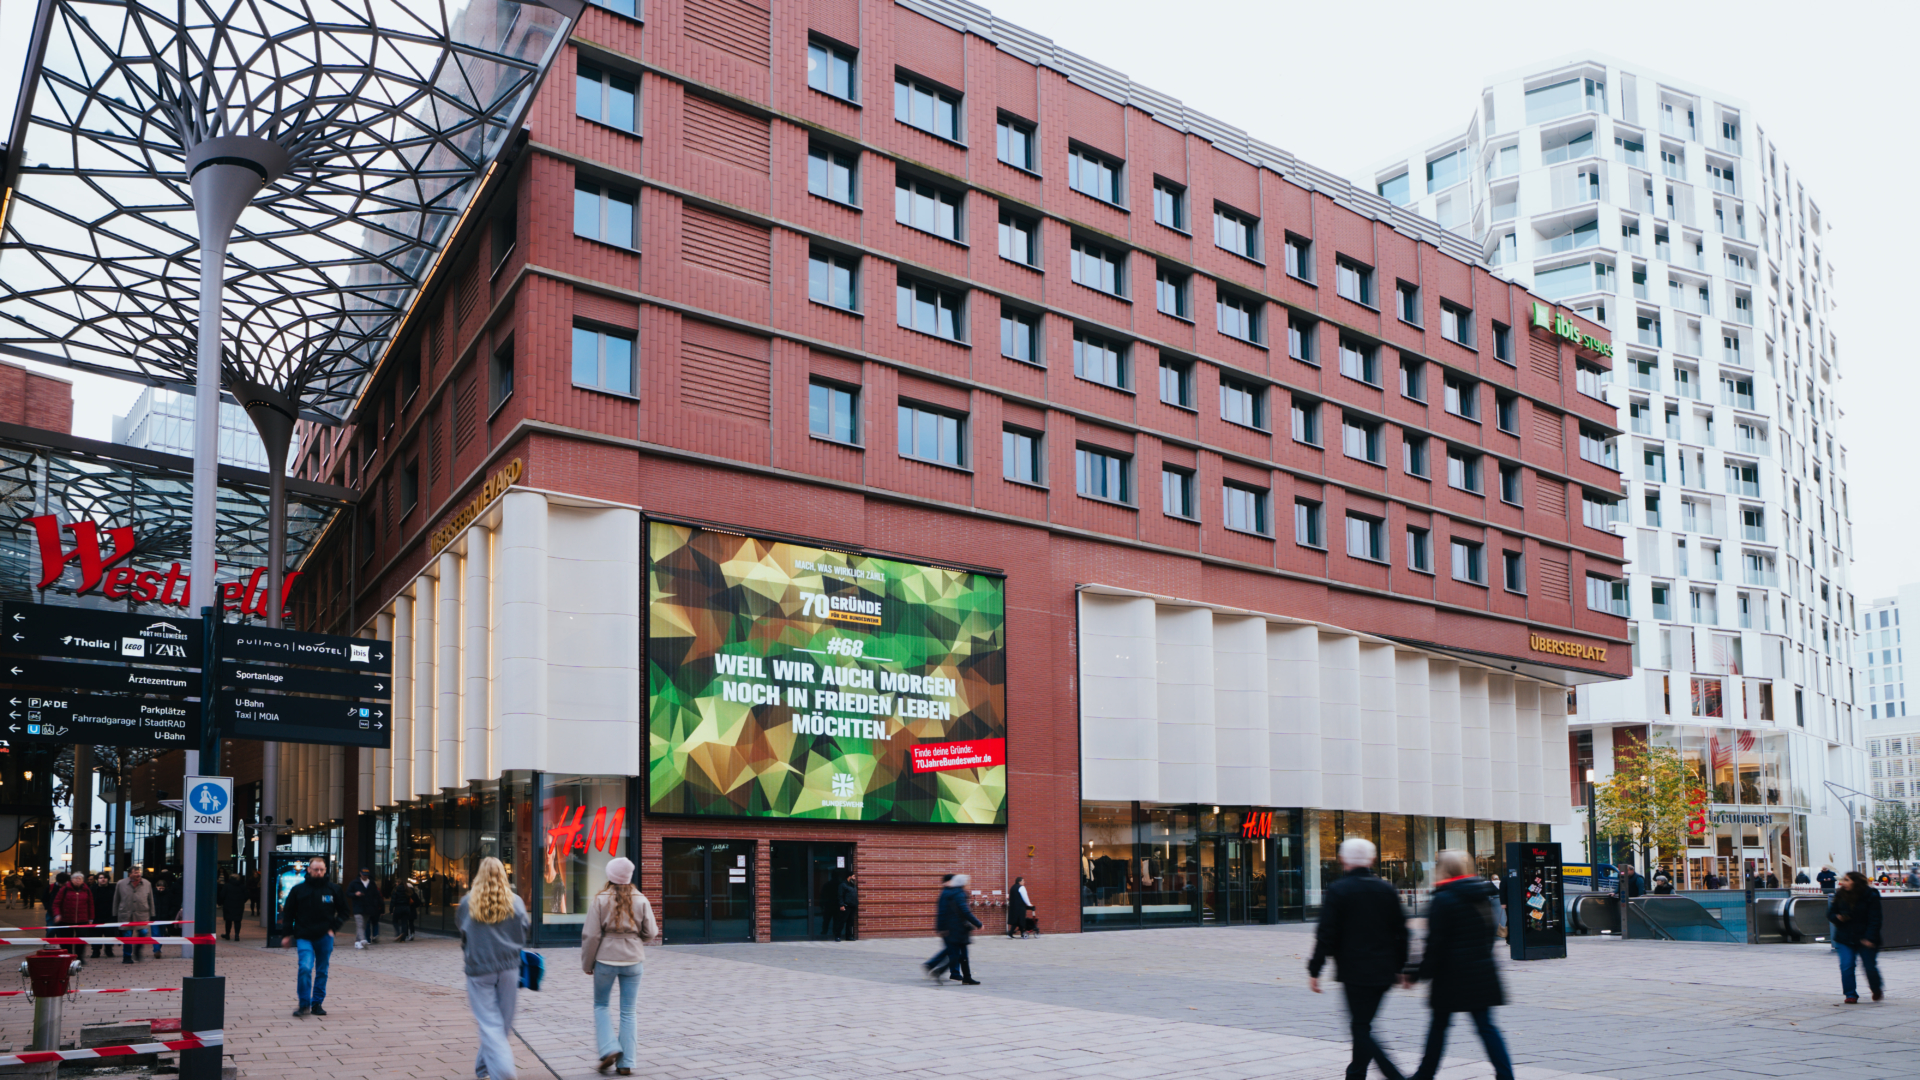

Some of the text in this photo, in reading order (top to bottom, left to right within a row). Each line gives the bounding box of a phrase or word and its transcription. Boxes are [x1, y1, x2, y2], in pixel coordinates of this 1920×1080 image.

[1554, 312, 1580, 344] ibis
[22, 514, 304, 618] Westeld
[794, 560, 886, 582] MACH, WAS WIRKLICH ZÄHLT.
[800, 592, 830, 618] 70
[830, 596, 882, 616] GRÜNDE
[74, 637, 110, 649] Thalia
[155, 643, 188, 658] ZARA
[236, 638, 366, 658] pullman NOVOTEL ibis
[826, 636, 864, 658] #68
[1530, 632, 1608, 662] ÜBERSEEPLATZ
[128, 674, 187, 687] Ärztezentrum
[236, 670, 284, 683] Sportanlage
[714, 652, 956, 698] WEIL WIR AUCH MORGEN
[235, 698, 264, 708] U-Bahn
[722, 680, 950, 720] NOCH IN FRIEDEN LEBEN
[140, 705, 186, 716] Parkplätze
[235, 710, 280, 721] Taxi MOIA
[72, 714, 186, 728] Fahrradgarage StadtRAD
[792, 710, 892, 741] MÖCHTEN.
[154, 732, 186, 741] U-Bahn
[914, 745, 974, 758] Finde deine Gründe:
[916, 754, 992, 770] 70JahreBundeswehr.de
[822, 800, 864, 808] BUNDESWEHR
[193, 814, 223, 825] ZONE
[1242, 811, 1273, 840] H&M
[548, 804, 626, 858] H&M
[1028, 844, 1036, 858] 2
[1562, 866, 1583, 874] SEGUR
